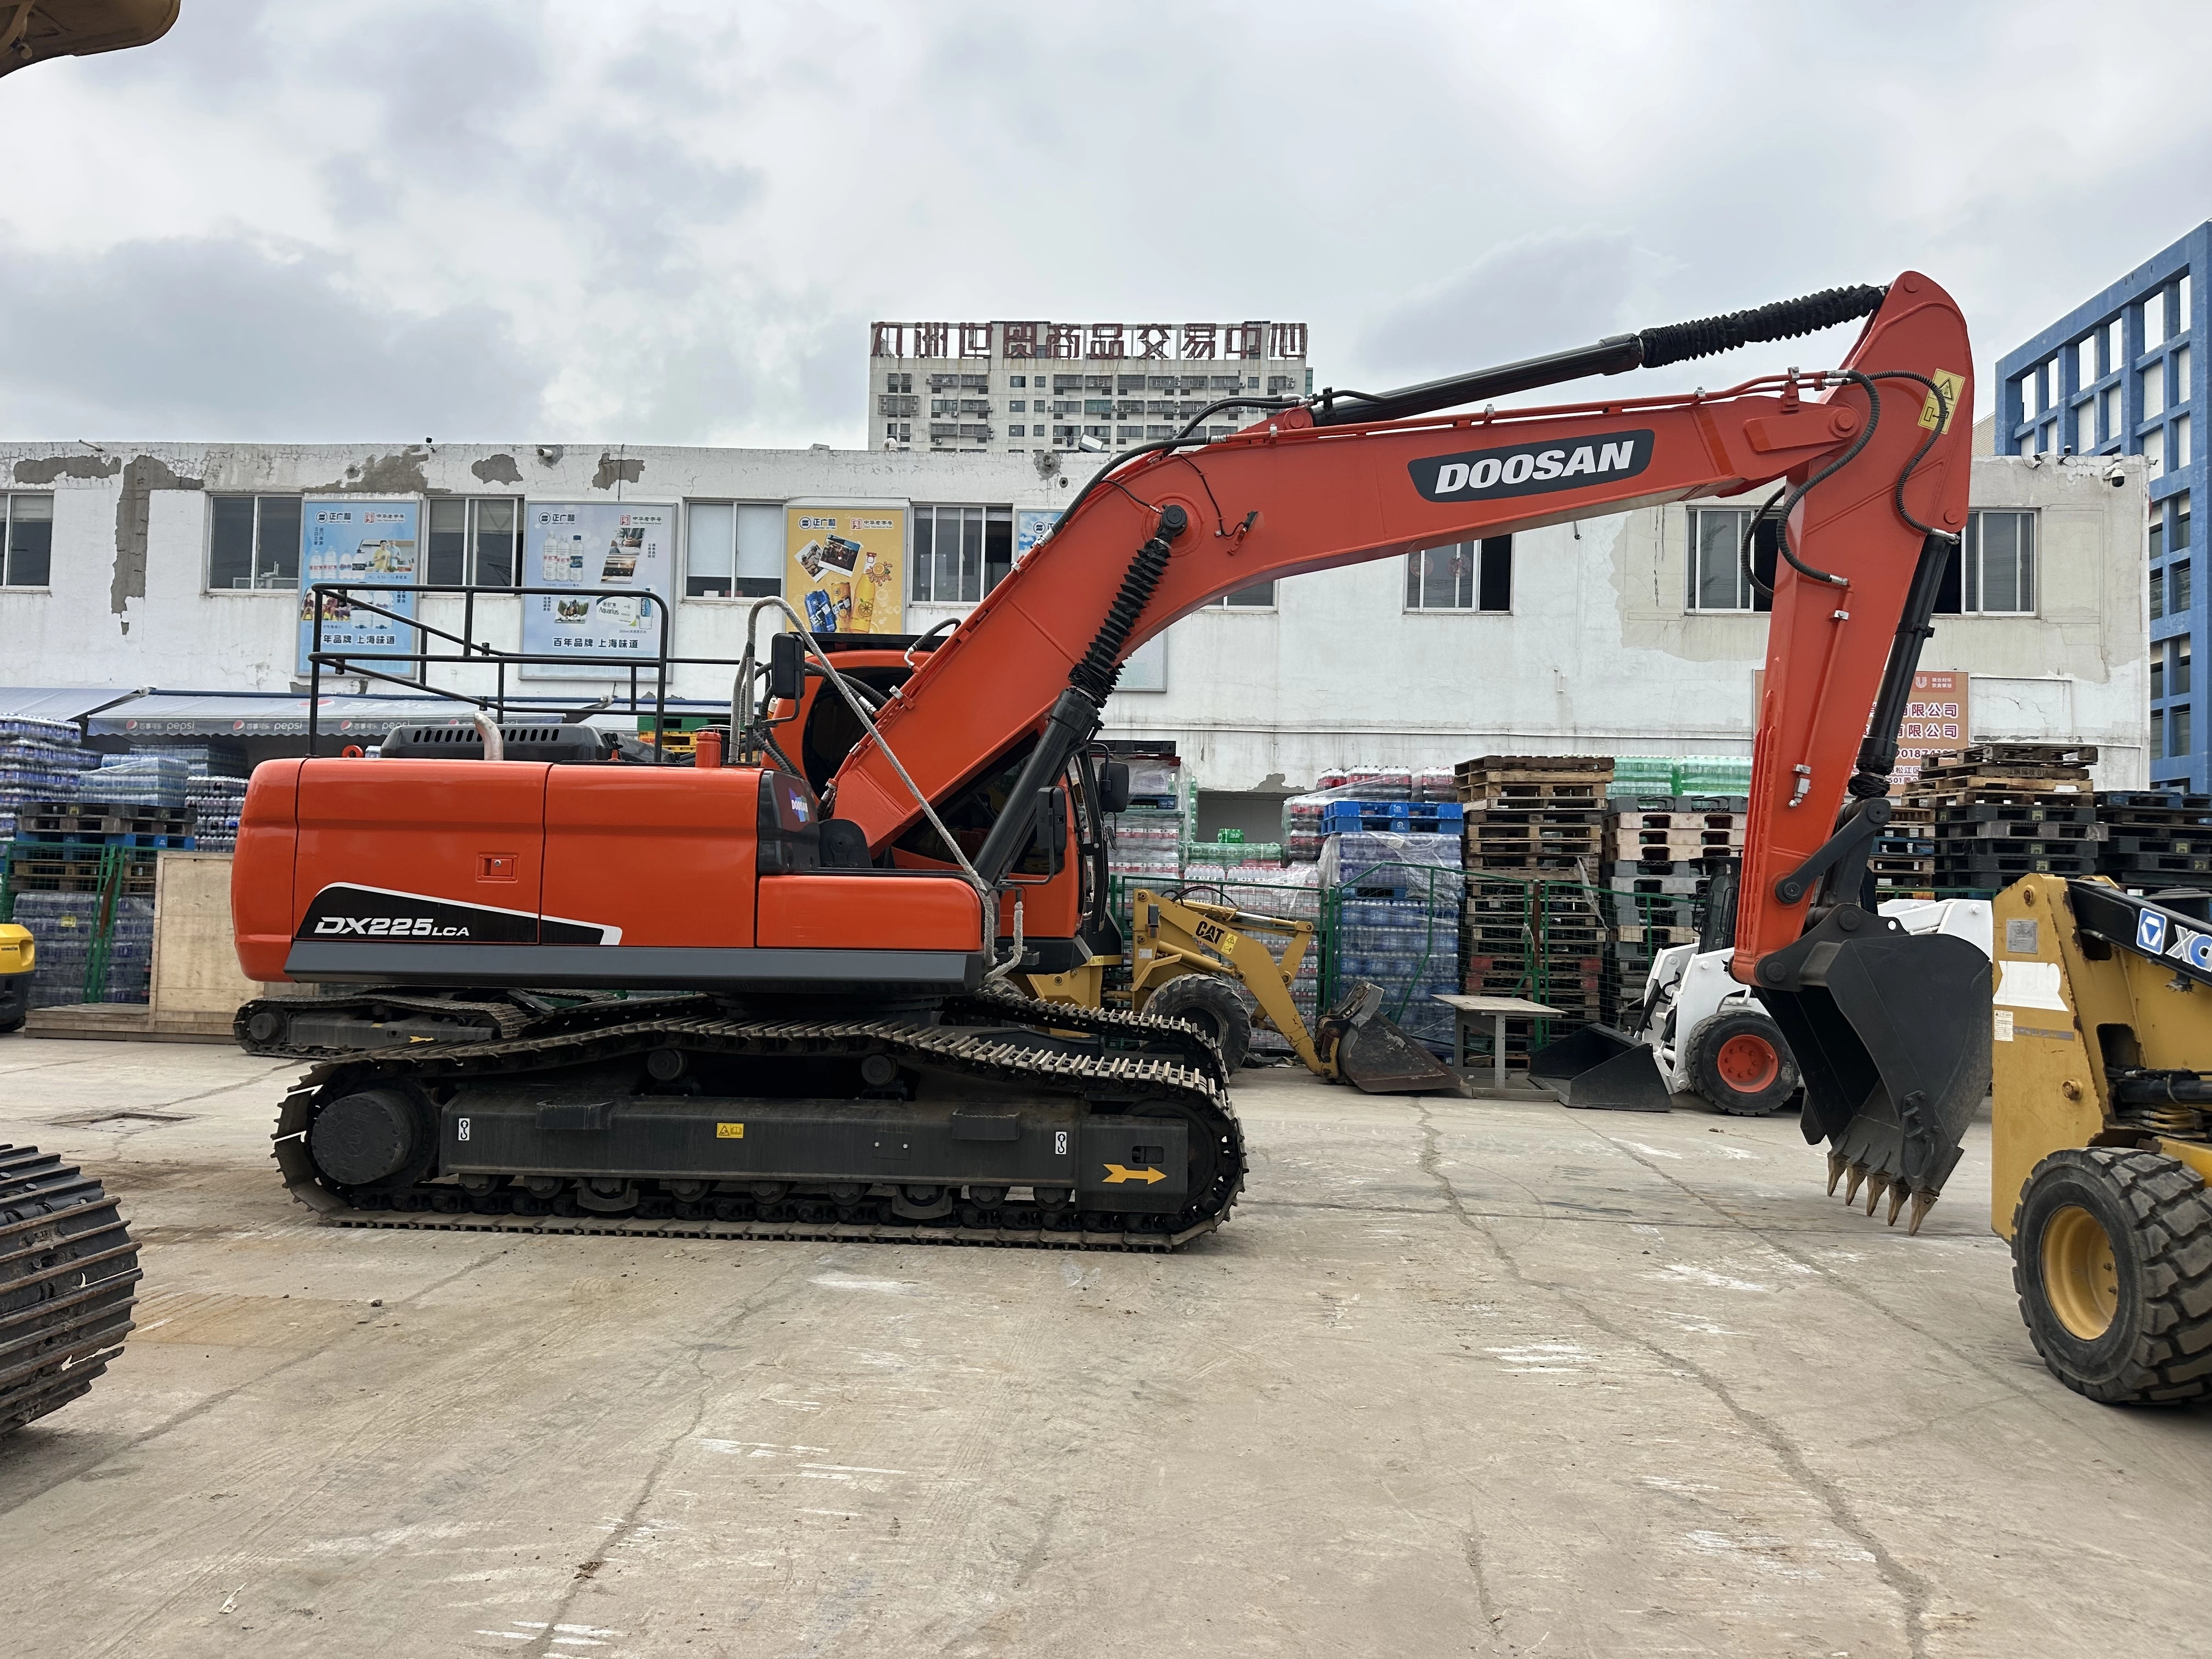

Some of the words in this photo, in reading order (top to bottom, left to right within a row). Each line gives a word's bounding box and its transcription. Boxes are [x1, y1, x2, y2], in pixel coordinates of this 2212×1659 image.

[1434, 439, 1635, 494] DOOSAN
[599, 606, 619, 616] Aquarius
[320, 634, 352, 644] 年品牌
[356, 634, 396, 645] 上海味道
[553, 637, 594, 648] 百年品牌
[597, 638, 639, 649] 上海味道
[166, 720, 195, 732] pepsi
[274, 720, 302, 732] pepsi
[791, 799, 809, 813] DOOSAN
[1195, 921, 1226, 945] CAT
